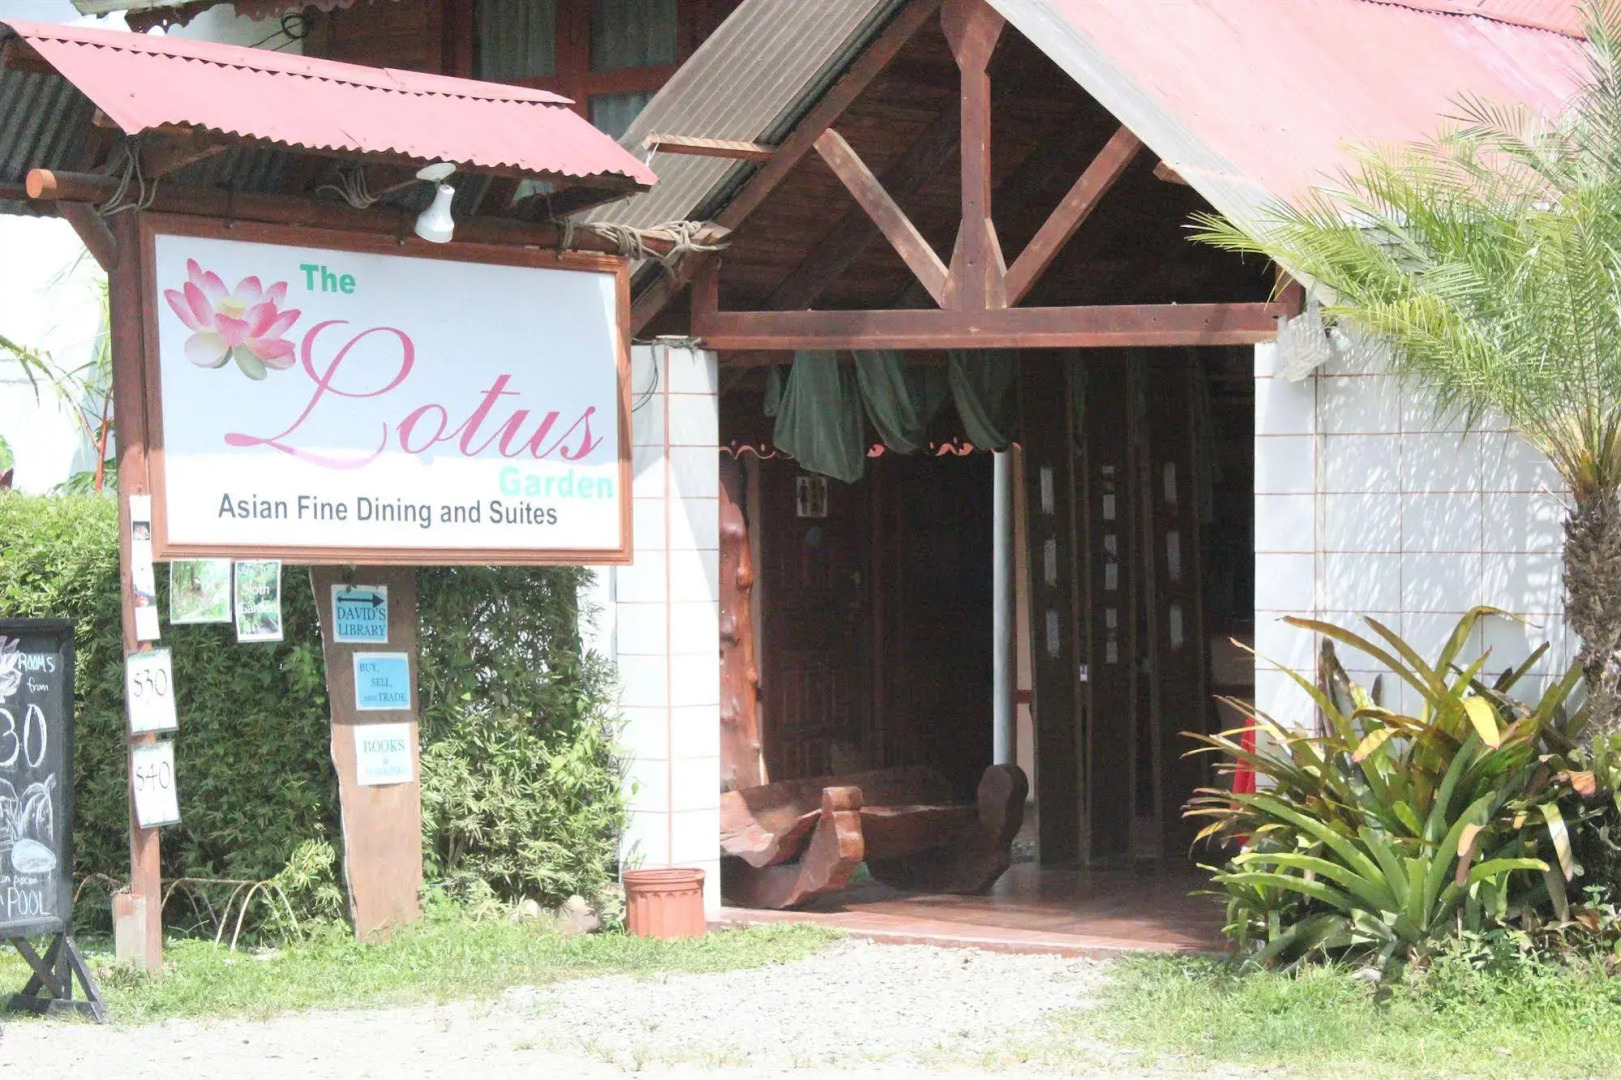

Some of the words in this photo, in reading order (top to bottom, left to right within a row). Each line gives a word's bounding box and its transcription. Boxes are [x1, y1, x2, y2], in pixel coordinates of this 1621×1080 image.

[300, 264, 356, 294] The
[224, 319, 604, 469] Lotus
[500, 466, 614, 499] Garden
[218, 493, 288, 520] Asian
[298, 495, 348, 521] Fine
[357, 497, 432, 528] Dining
[440, 500, 481, 525] and
[489, 501, 558, 526] Suites
[337, 606, 387, 621] DAVID'S
[338, 623, 386, 637] LIBRARY
[18, 653, 55, 673] ROOMS
[27, 676, 49, 693] from
[378, 691, 407, 702] TRADE
[363, 739, 405, 754] BOOKS
[8, 887, 51, 917] POOL
